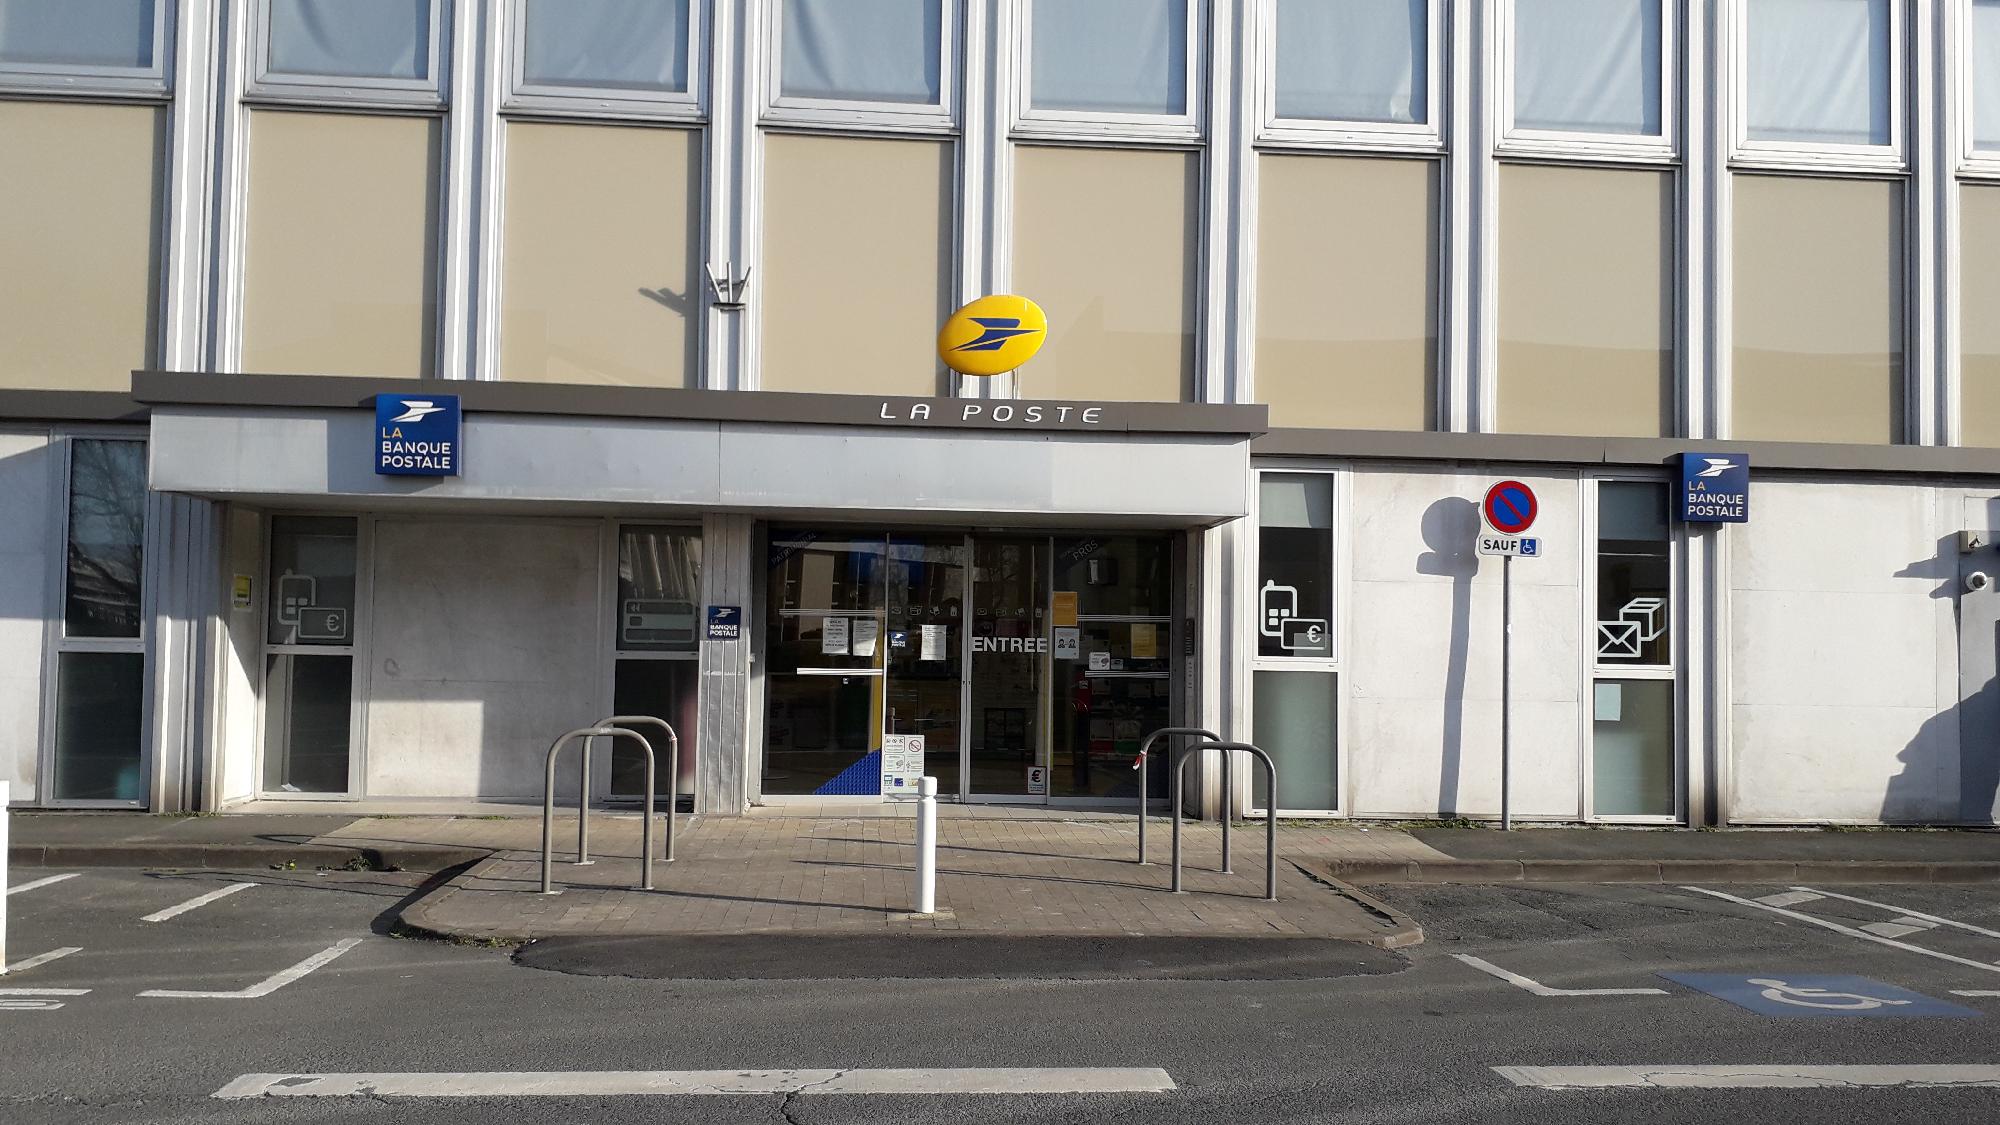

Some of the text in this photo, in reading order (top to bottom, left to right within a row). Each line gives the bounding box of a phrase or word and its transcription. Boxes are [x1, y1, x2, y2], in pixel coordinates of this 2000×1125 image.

[880, 402, 1102, 424] LA POSTE
[382, 426, 403, 439] LA
[382, 440, 451, 456] BANQUE
[382, 455, 451, 469] POSTALE
[1688, 480, 1706, 491] LA
[1688, 493, 1744, 505] BANQUE
[1687, 505, 1743, 517] POSTALE
[1483, 539, 1518, 551] SAUF
[971, 636, 1048, 653] ENTREE
